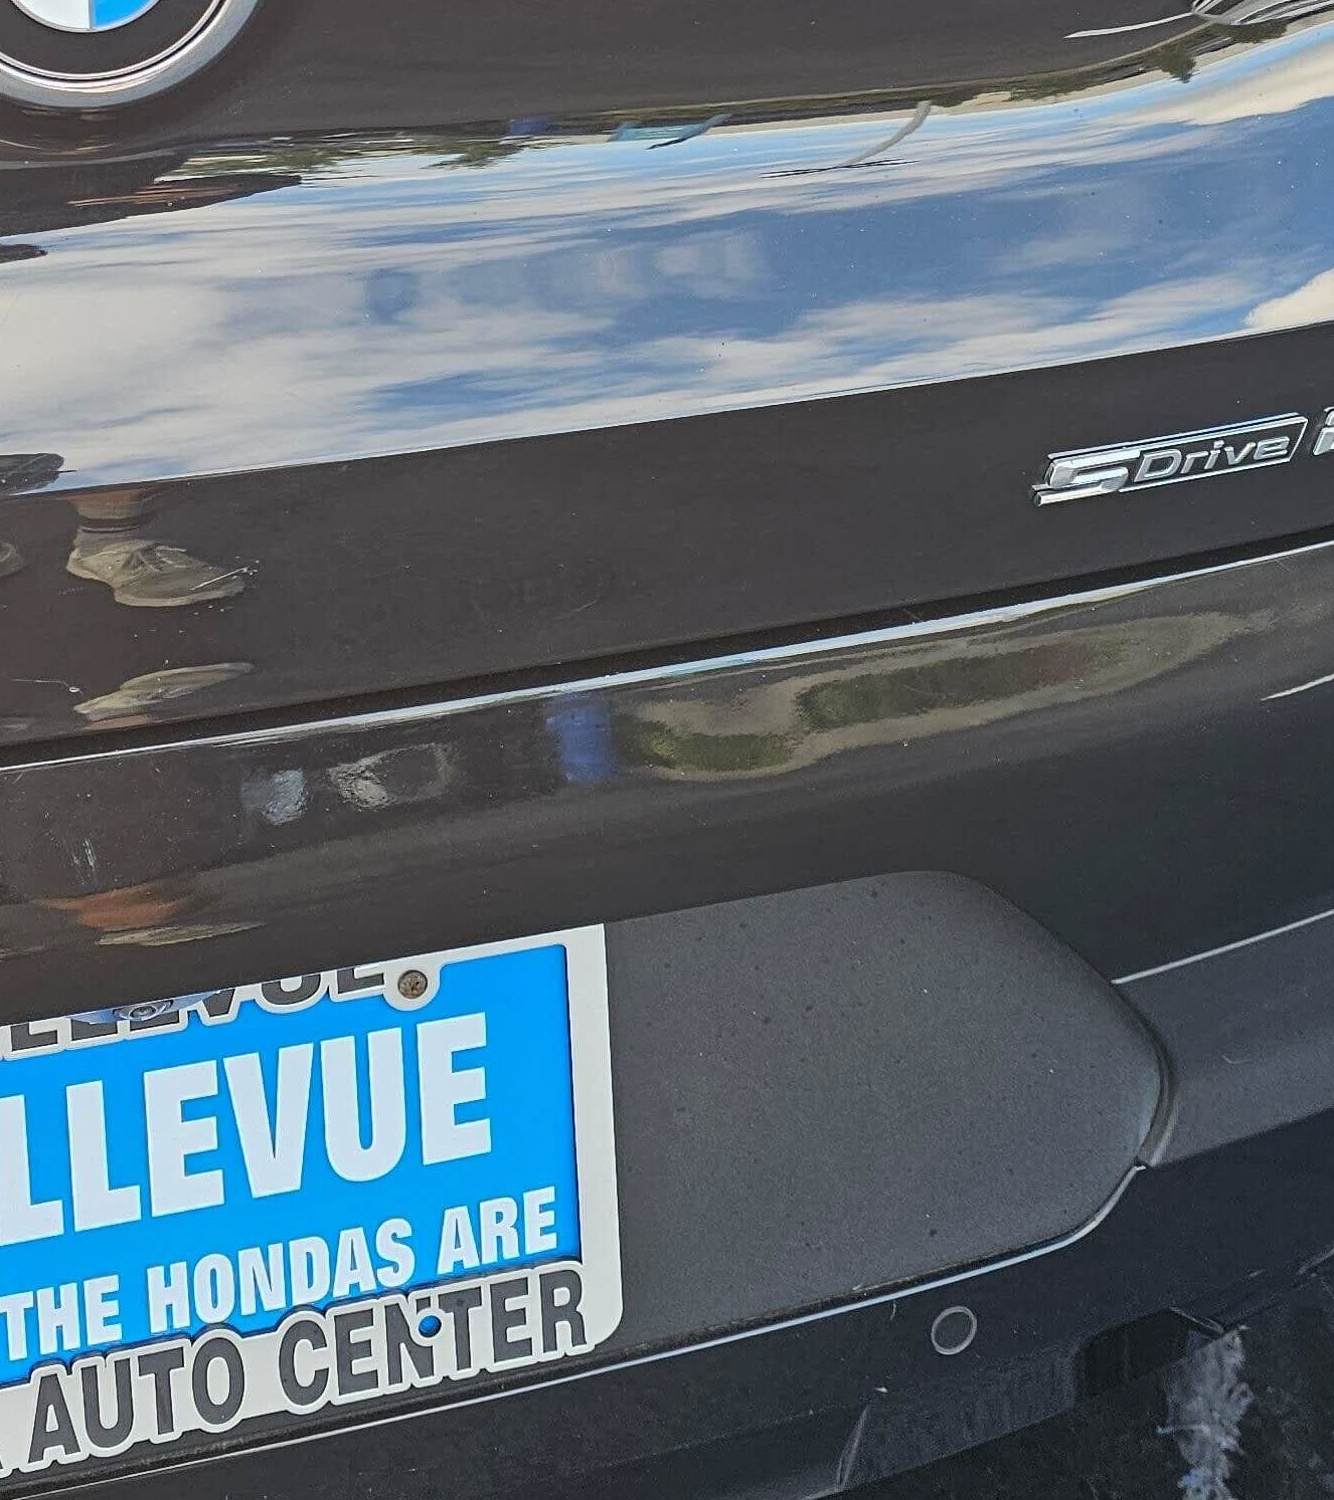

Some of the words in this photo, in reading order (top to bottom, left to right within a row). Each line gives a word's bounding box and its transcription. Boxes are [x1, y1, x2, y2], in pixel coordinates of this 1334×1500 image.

[146, 1218, 416, 1335] HONDAS
[436, 1187, 560, 1275] ARE
[27, 1336, 246, 1465] AUTO
[277, 1269, 588, 1408] CENTER
